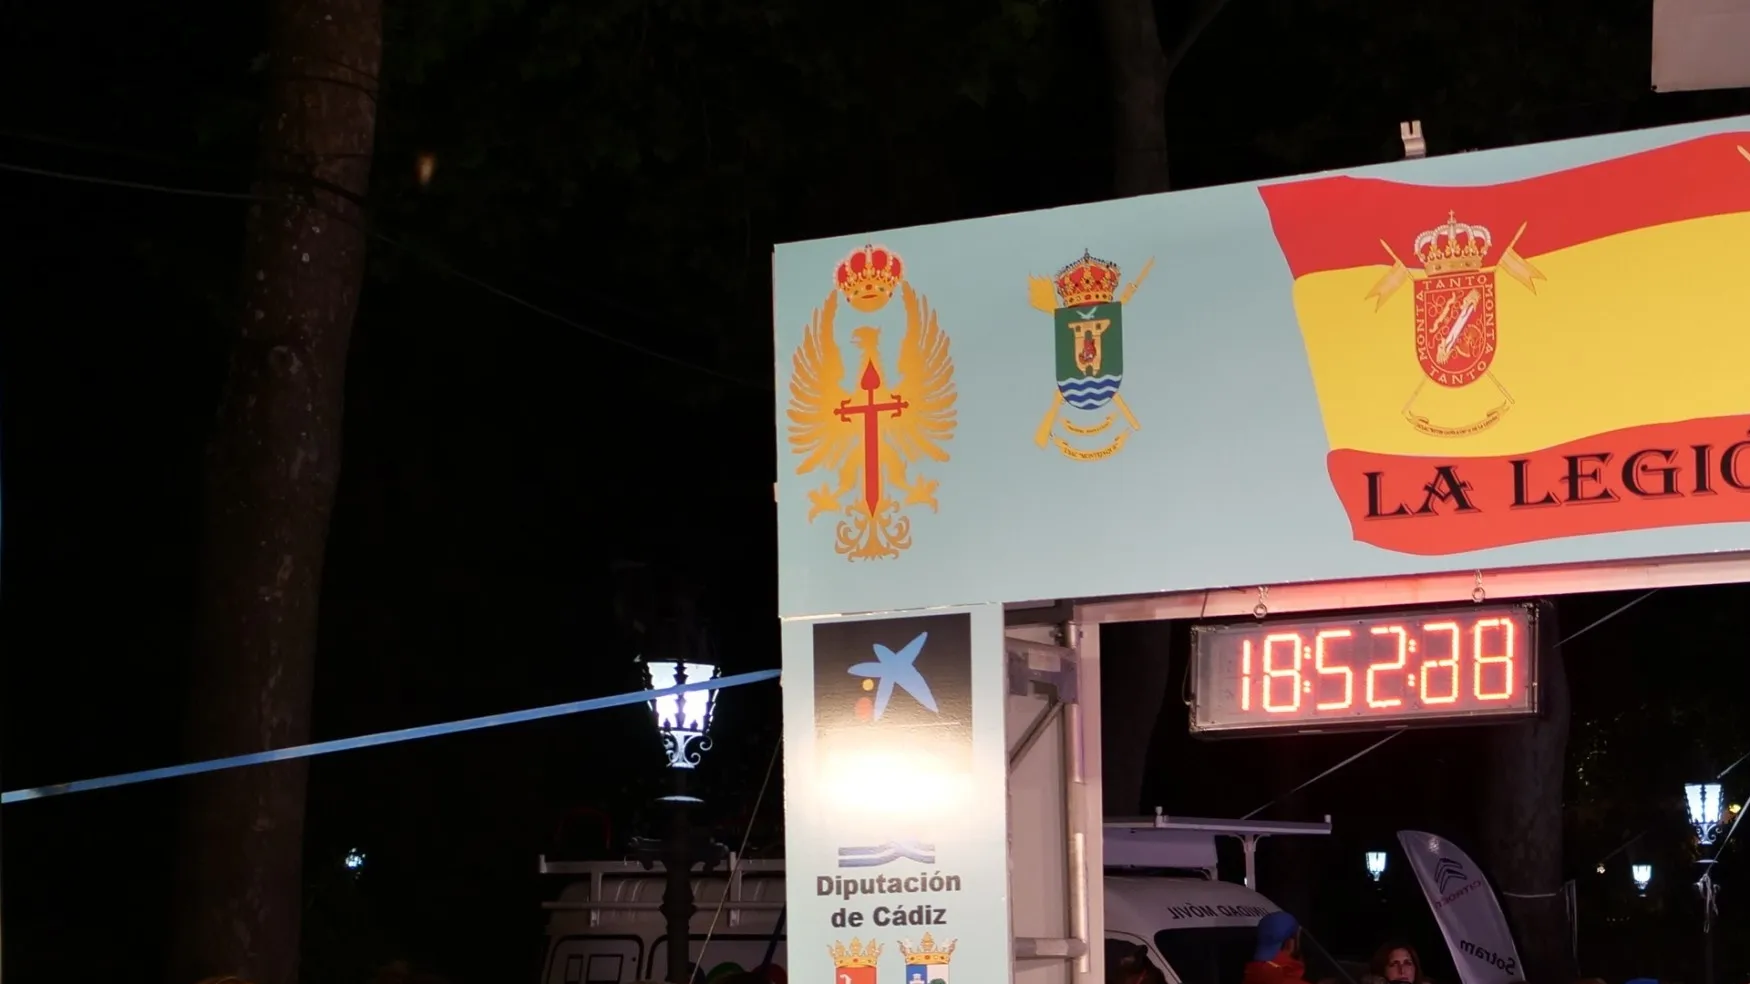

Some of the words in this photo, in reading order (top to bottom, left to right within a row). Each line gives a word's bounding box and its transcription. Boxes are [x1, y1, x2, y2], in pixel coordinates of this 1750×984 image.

[1422, 274, 1487, 291] TANTO
[1415, 289, 1428, 361] MONTA
[1484, 283, 1495, 354] MONTA
[1429, 361, 1487, 386] TANTO
[1363, 465, 1483, 521] LA
[816, 871, 962, 900] Diputación
[831, 907, 864, 928] de
[872, 904, 947, 927] Cádiz
